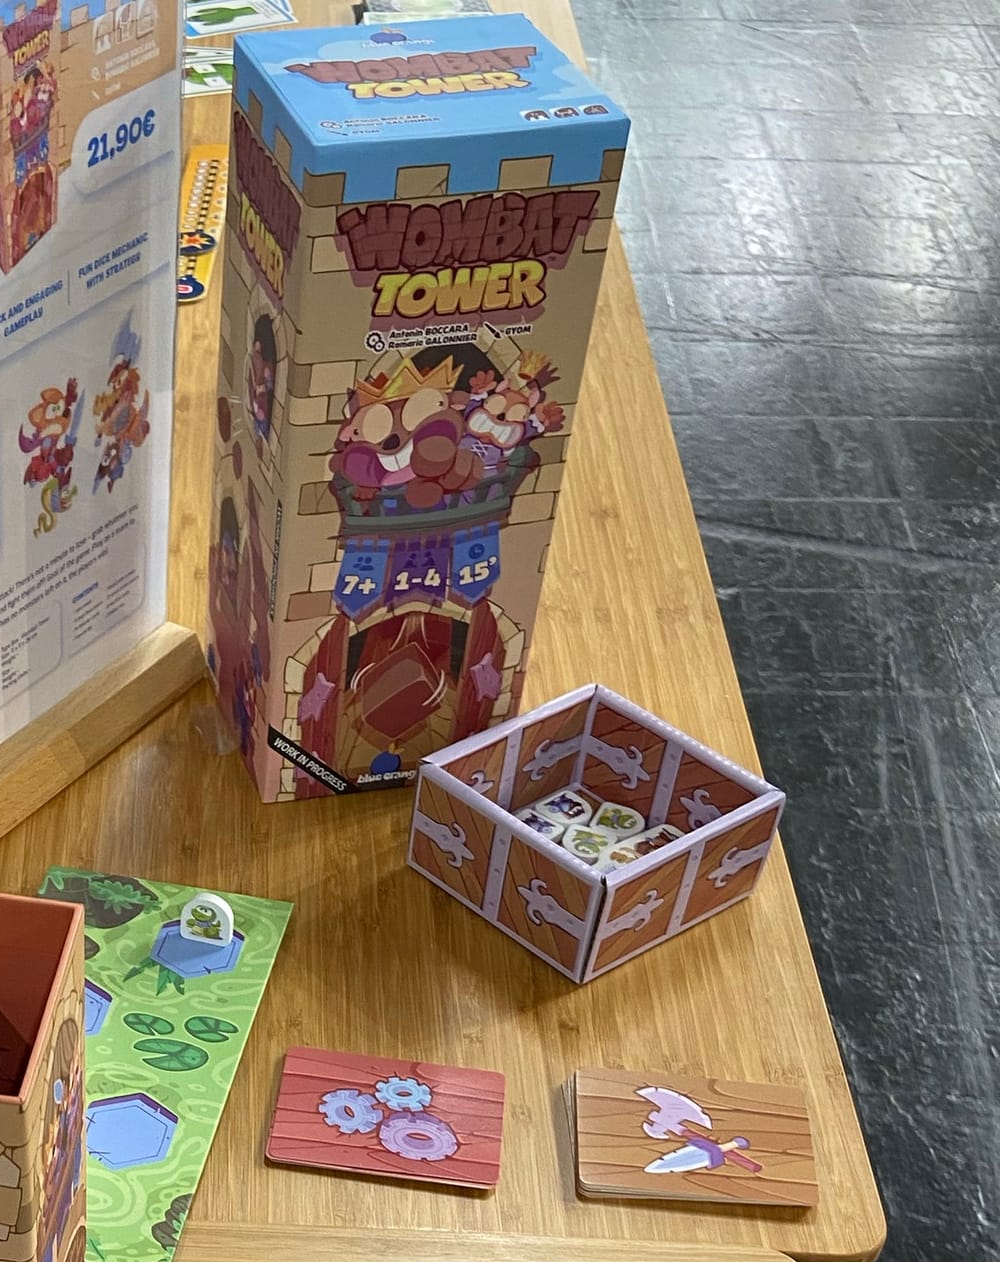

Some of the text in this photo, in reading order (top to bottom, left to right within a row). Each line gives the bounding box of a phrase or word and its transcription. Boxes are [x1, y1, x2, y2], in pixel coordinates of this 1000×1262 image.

[285, 46, 536, 84] WOMBAT
[346, 70, 530, 100] TOWER
[87, 109, 155, 168] 21,90€
[239, 192, 285, 300] TOWER
[337, 190, 600, 271] WOMBAT
[78, 232, 149, 278] FUN DICE MECHANIC
[86, 251, 141, 289] WITH STRATEGY
[8, 302, 24, 319] AND
[25, 279, 63, 309] ENGAGING
[371, 259, 547, 318] TOWER
[4, 306, 43, 337] GAMEPLAY
[425, 324, 469, 336] BOCCARA
[425, 333, 477, 346] GALONNIER
[505, 325, 531, 336] GYOM
[342, 575, 376, 595] 7+
[394, 568, 441, 591] 1-4
[274, 738, 347, 791] WORK IN PROGRESS
[357, 770, 418, 783] blue orang
